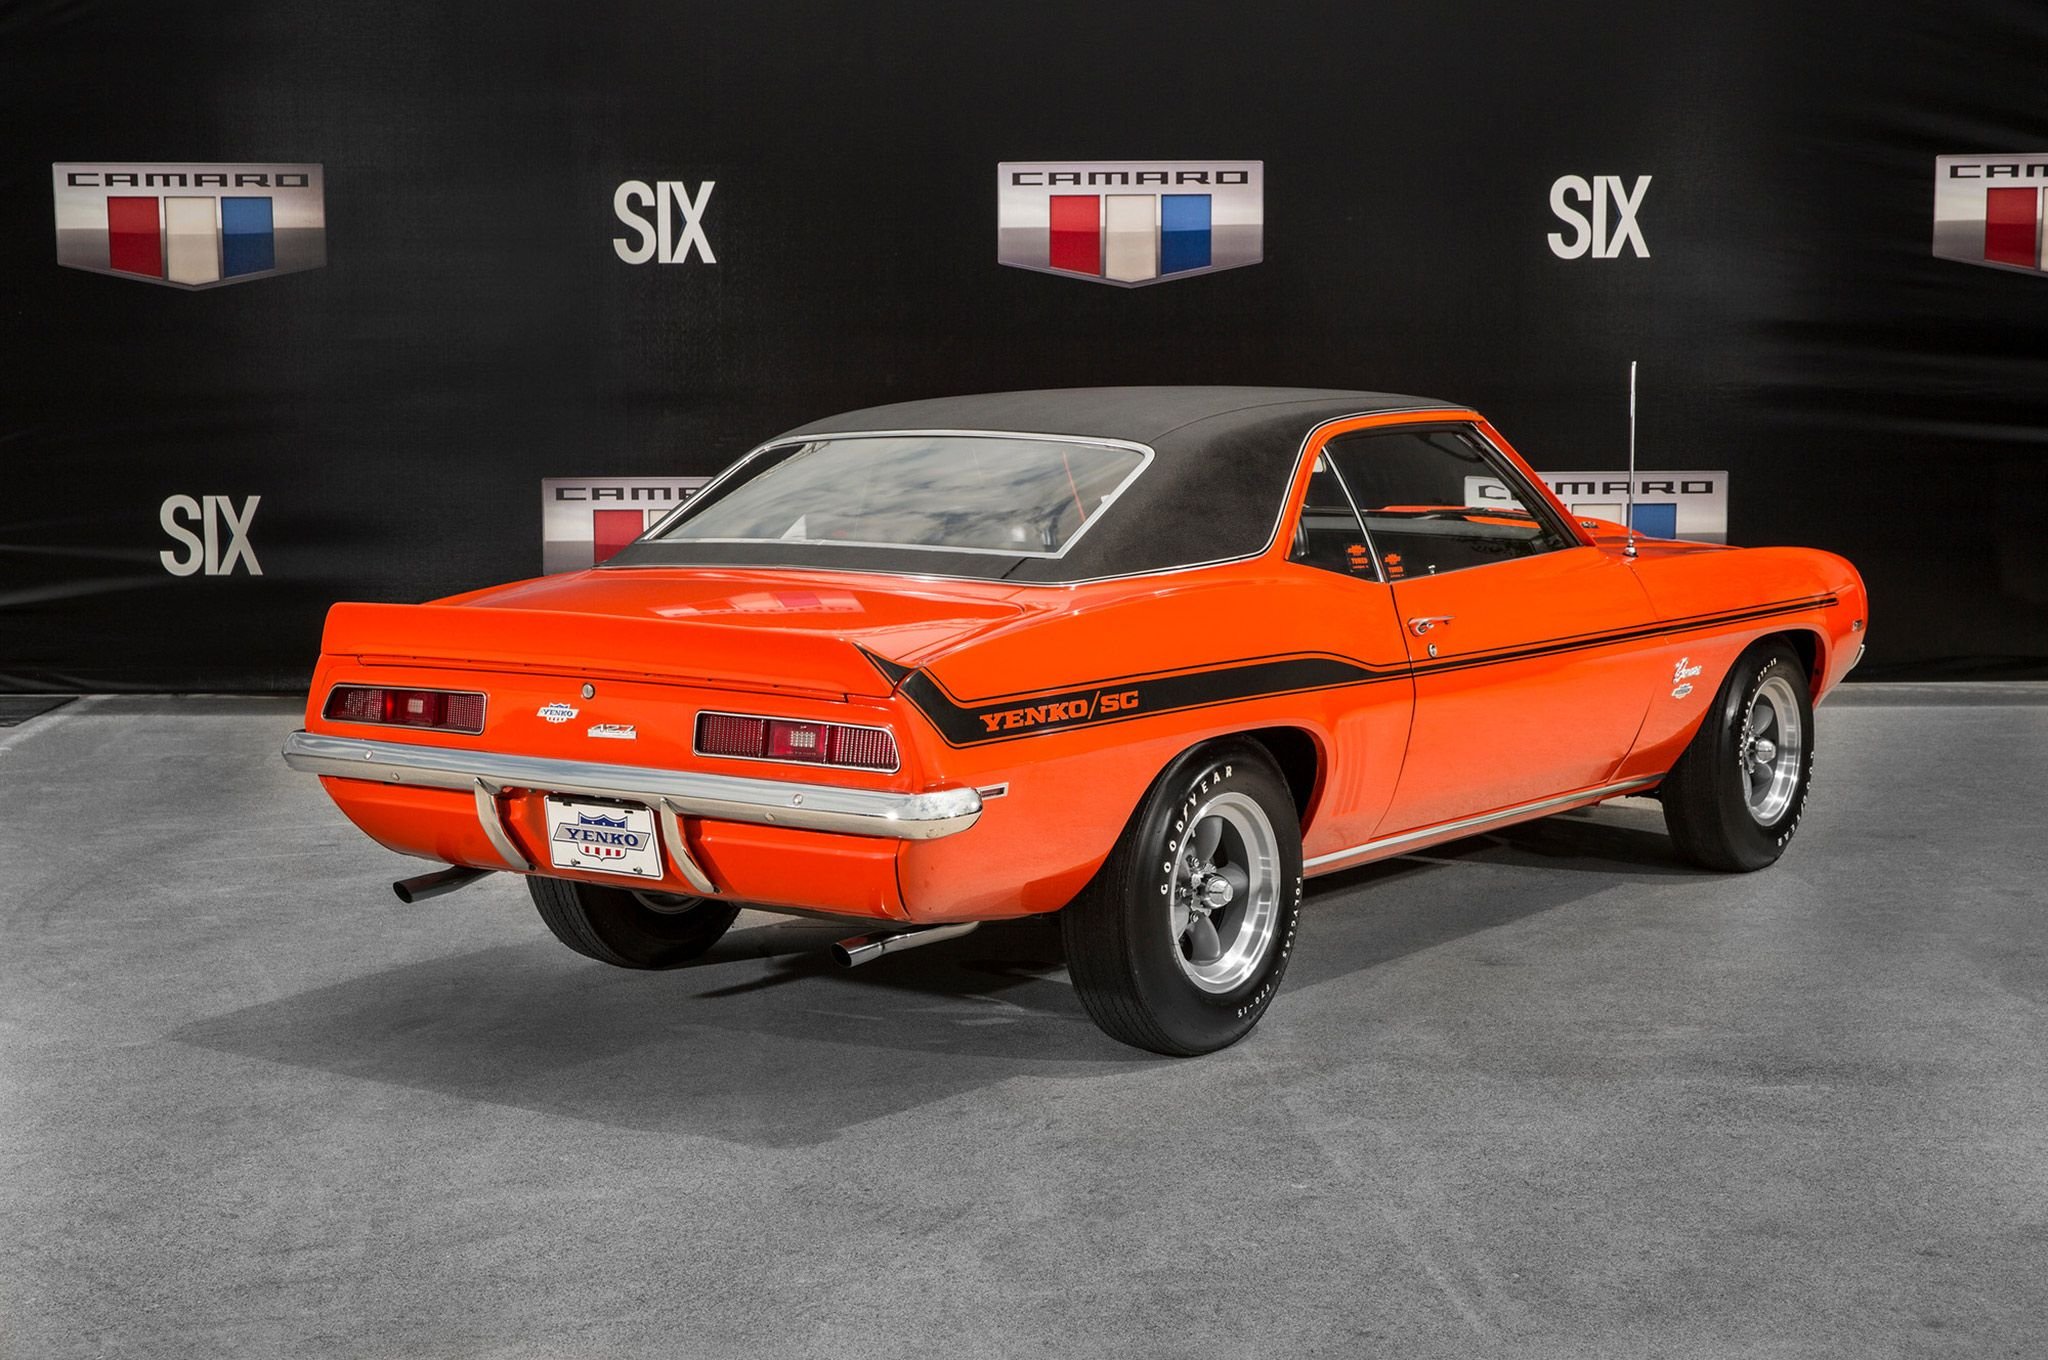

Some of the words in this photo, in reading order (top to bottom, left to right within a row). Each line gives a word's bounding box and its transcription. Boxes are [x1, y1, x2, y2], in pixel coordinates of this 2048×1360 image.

[68, 173, 310, 188] CAMARO
[1012, 171, 1248, 186] CAMARO
[613, 180, 717, 265] SIX
[1548, 174, 1653, 260] SIX
[160, 494, 263, 577] SIX
[542, 708, 574, 718] YENKO
[565, 826, 639, 848] YENKO
[1160, 765, 1233, 895] GOODYEAR
